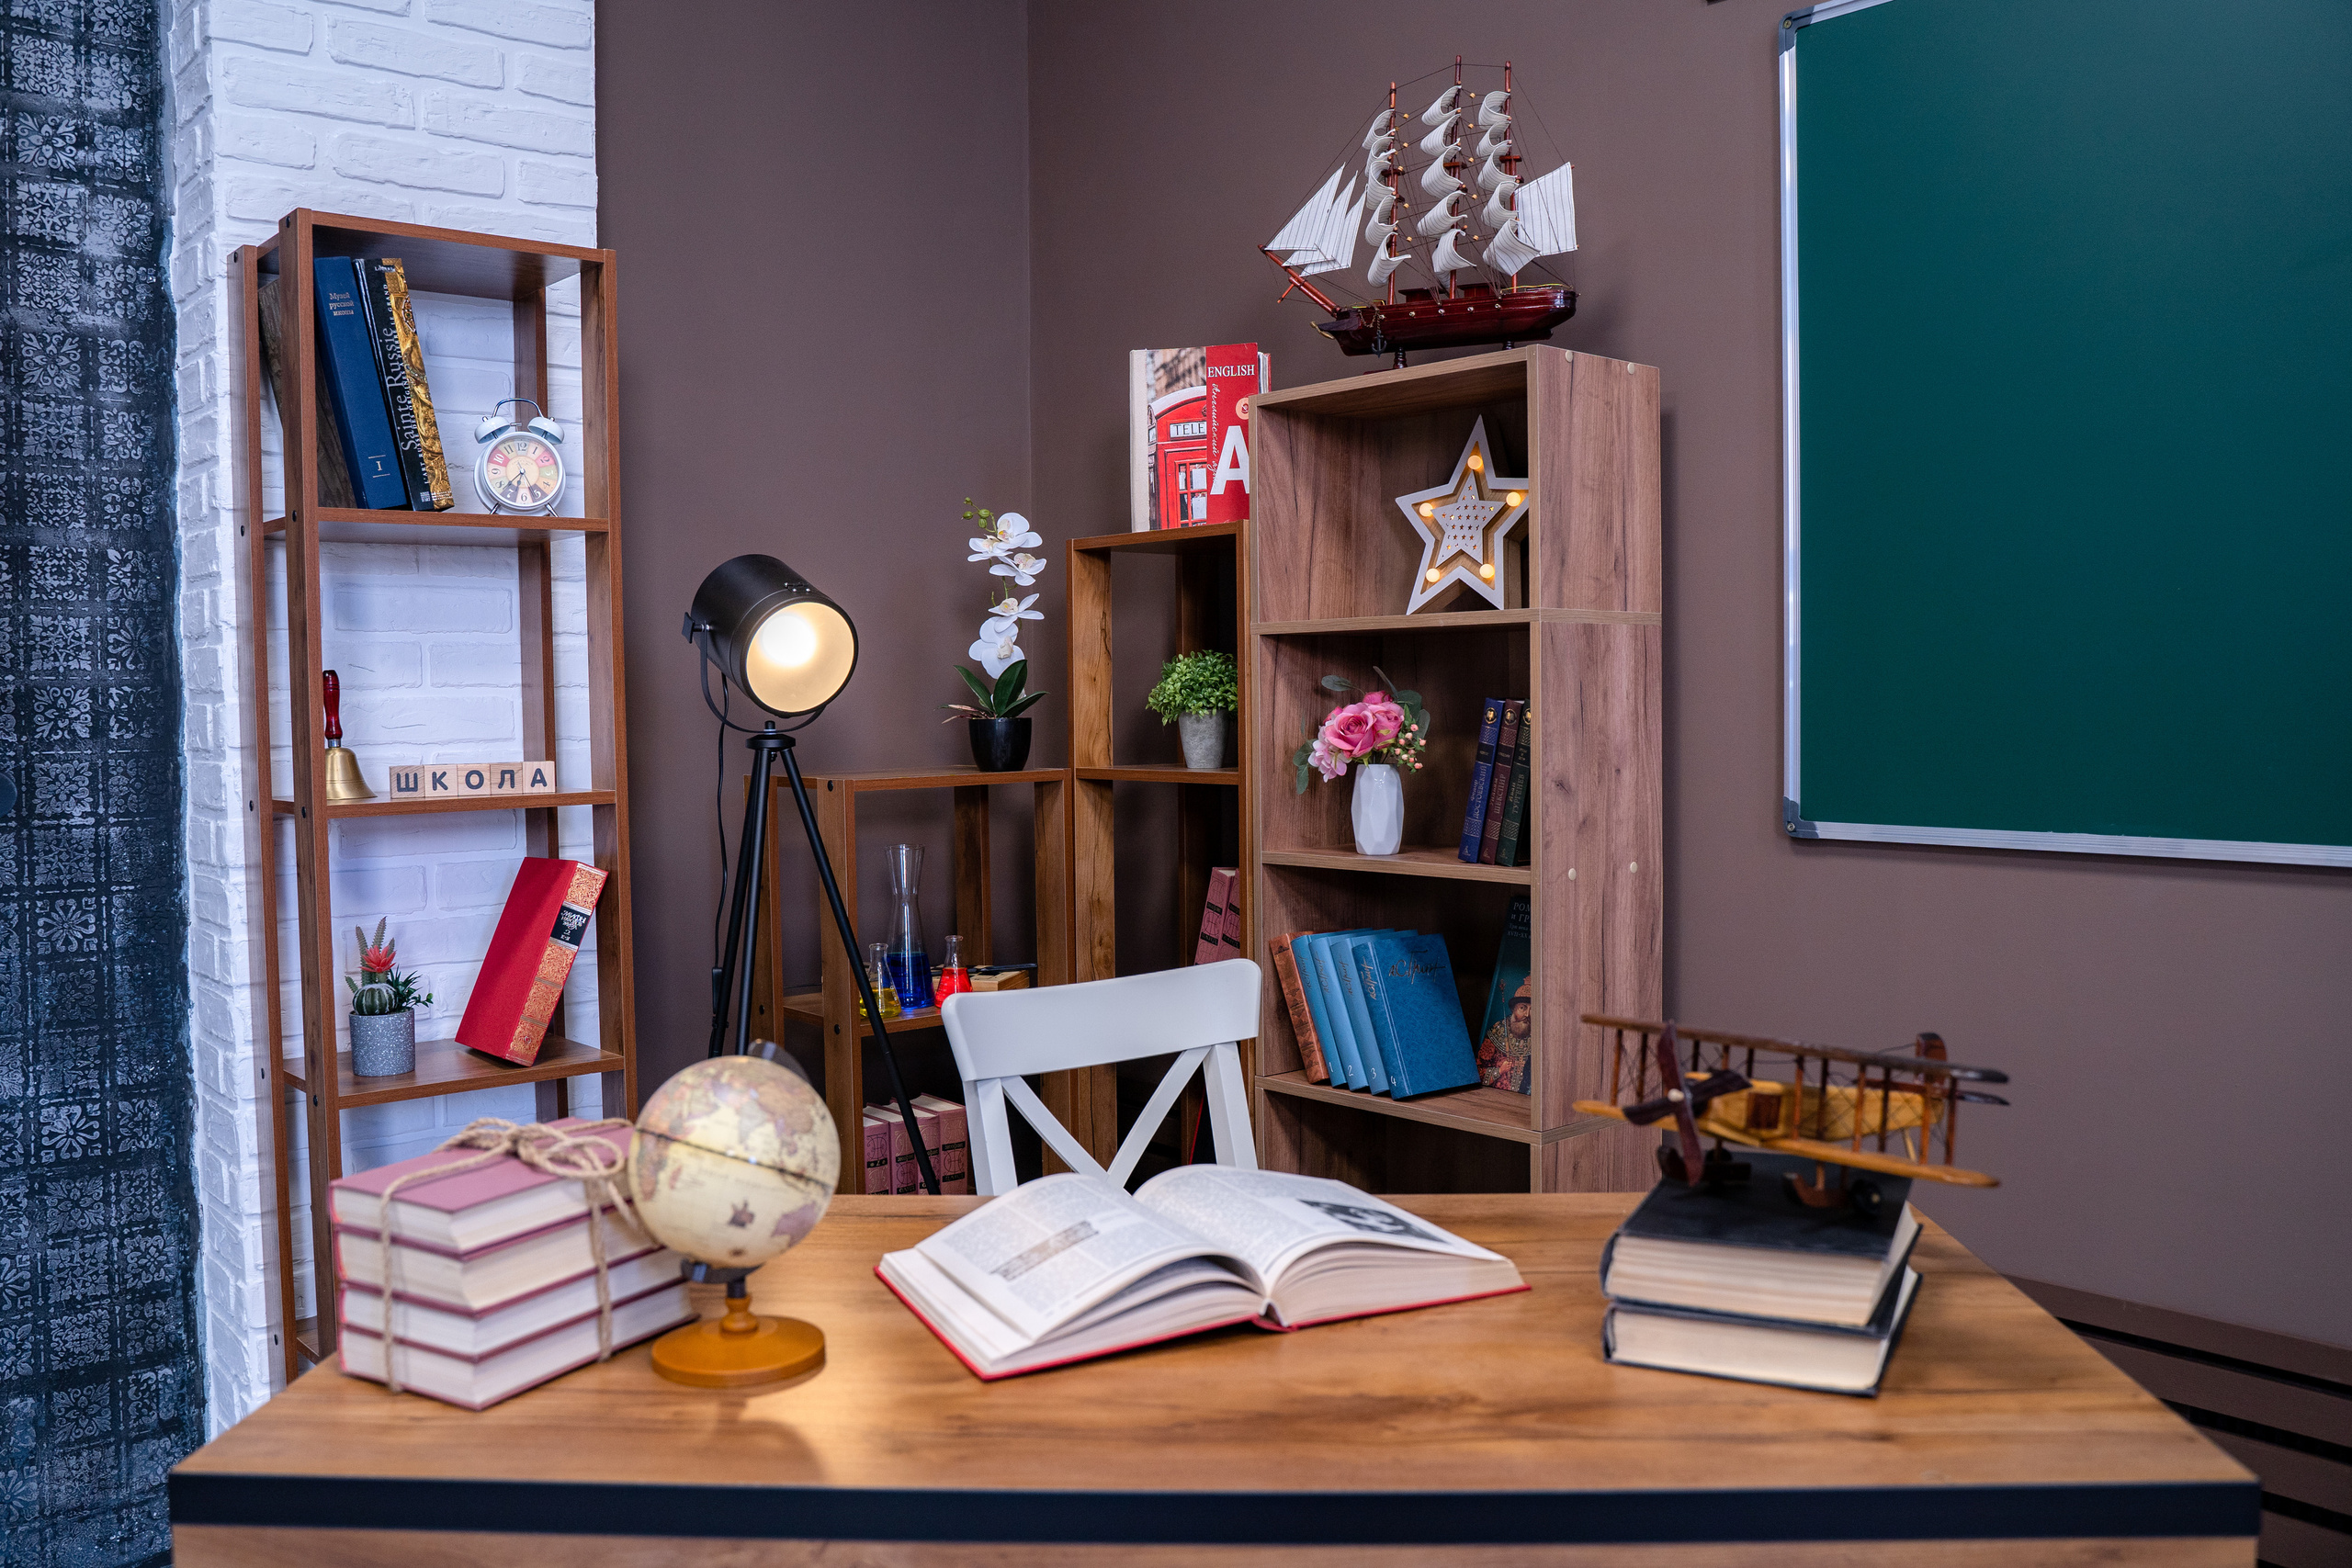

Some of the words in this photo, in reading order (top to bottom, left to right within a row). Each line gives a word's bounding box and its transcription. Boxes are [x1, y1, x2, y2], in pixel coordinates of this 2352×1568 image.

[329, 292, 350, 300] Музей
[383, 284, 393, 312] GRAND
[329, 300, 355, 310] русской
[379, 328, 406, 388] Russie
[1207, 365, 1255, 378] ENGLISH
[396, 395, 418, 450] Sainte
[1211, 383, 1221, 457] Английский
[1173, 423, 1205, 435] TELE
[503, 445, 514, 455] 11
[517, 443, 527, 451] 12
[532, 446, 538, 455] 1
[493, 453, 505, 464] 10
[420, 461, 430, 484] L'ART
[506, 489, 514, 499] 7
[521, 492, 527, 502] 6
[533, 489, 542, 500] 5
[397, 768, 548, 793] ШКОЛА
[1473, 765, 1487, 819] ДОСТОЕВСКИЙ
[1494, 773, 1507, 814] ШЕКСПИР
[1512, 774, 1525, 814] ТУРГЕНЕВ
[1329, 1062, 1334, 1073] 1
[1347, 1065, 1354, 1077] 2
[1370, 1067, 1377, 1079] 3
[1390, 1076, 1396, 1086] 4
